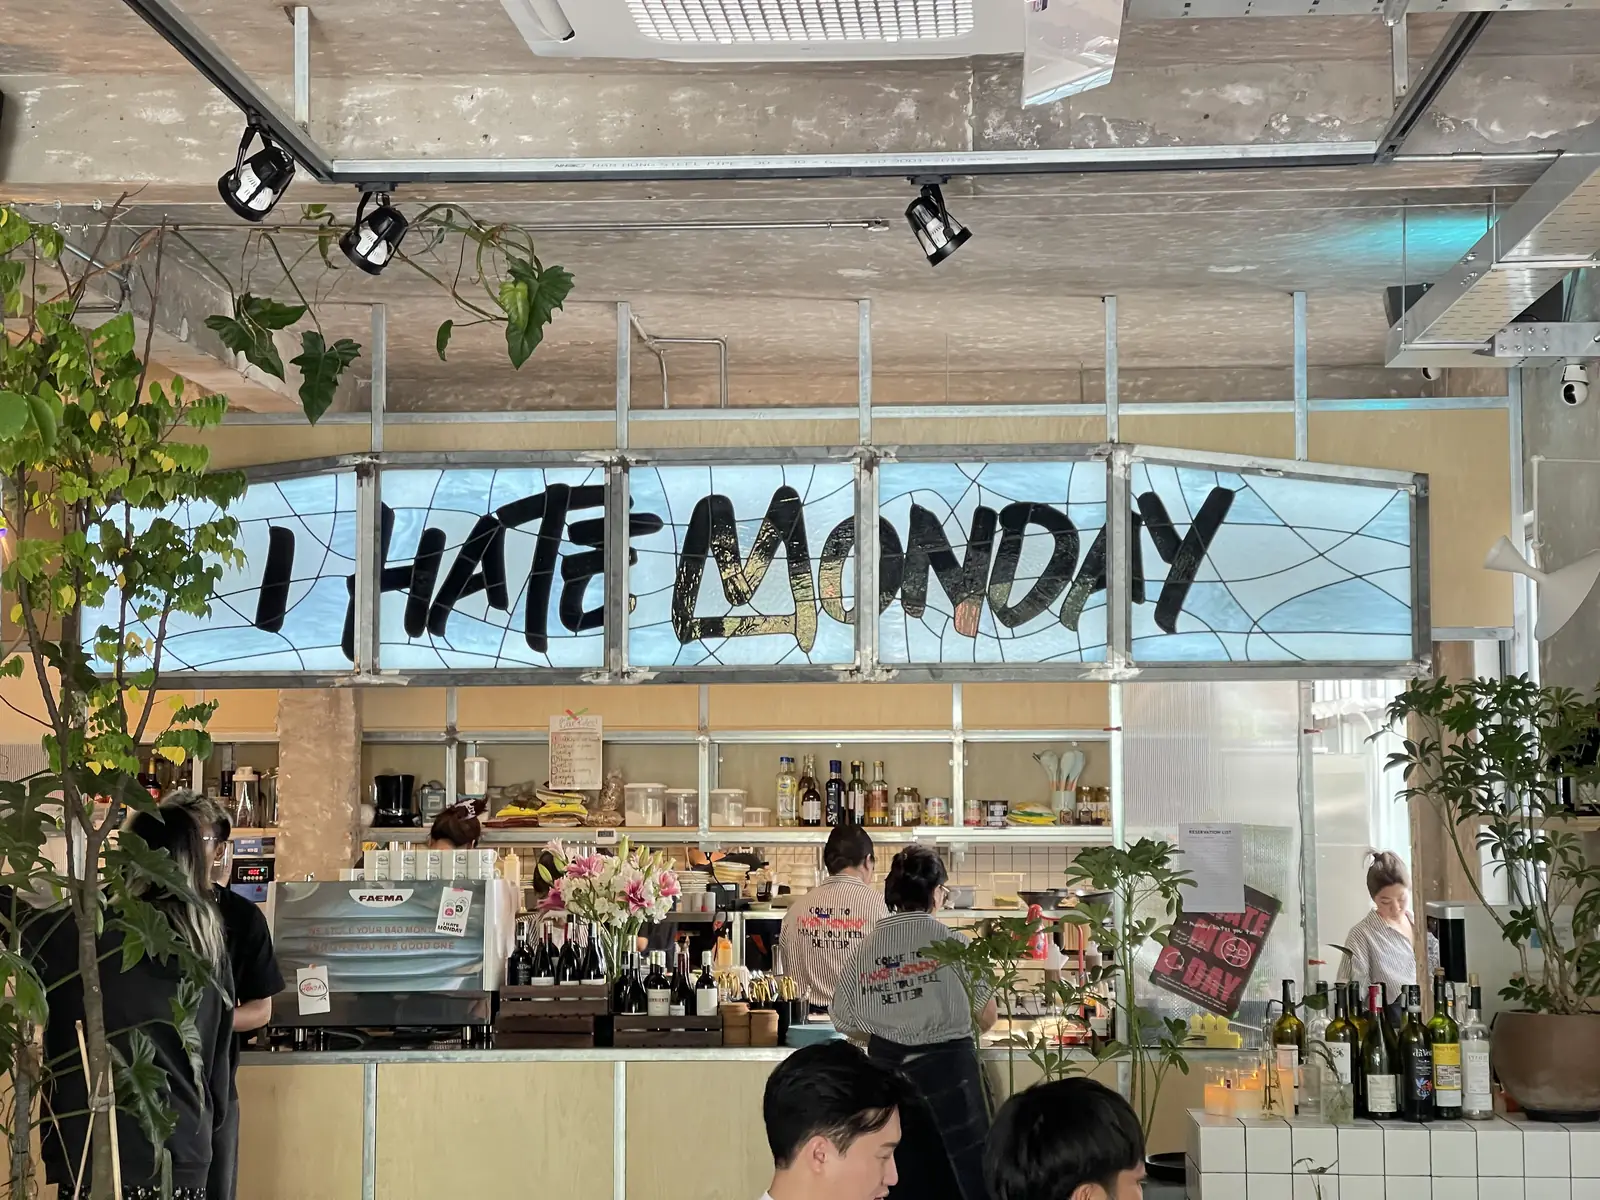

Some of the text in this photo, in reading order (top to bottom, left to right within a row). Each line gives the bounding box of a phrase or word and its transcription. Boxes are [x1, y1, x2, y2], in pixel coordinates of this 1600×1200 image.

[255, 483, 1235, 662] I HATE MONDAY
[358, 894, 404, 902] FAEMA
[809, 907, 851, 916] COME TO
[356, 925, 382, 934] YOUR
[384, 925, 403, 934] BAD
[438, 925, 463, 933] MONDAY
[797, 928, 865, 940] MAKE YOU FEEL
[355, 942, 376, 951] YOU
[400, 941, 431, 951] GOOD
[432, 941, 455, 950] ONE
[875, 953, 905, 967] COME
[861, 973, 942, 996] MAKE YOU FEEL
[1182, 957, 1242, 1002] DAY
